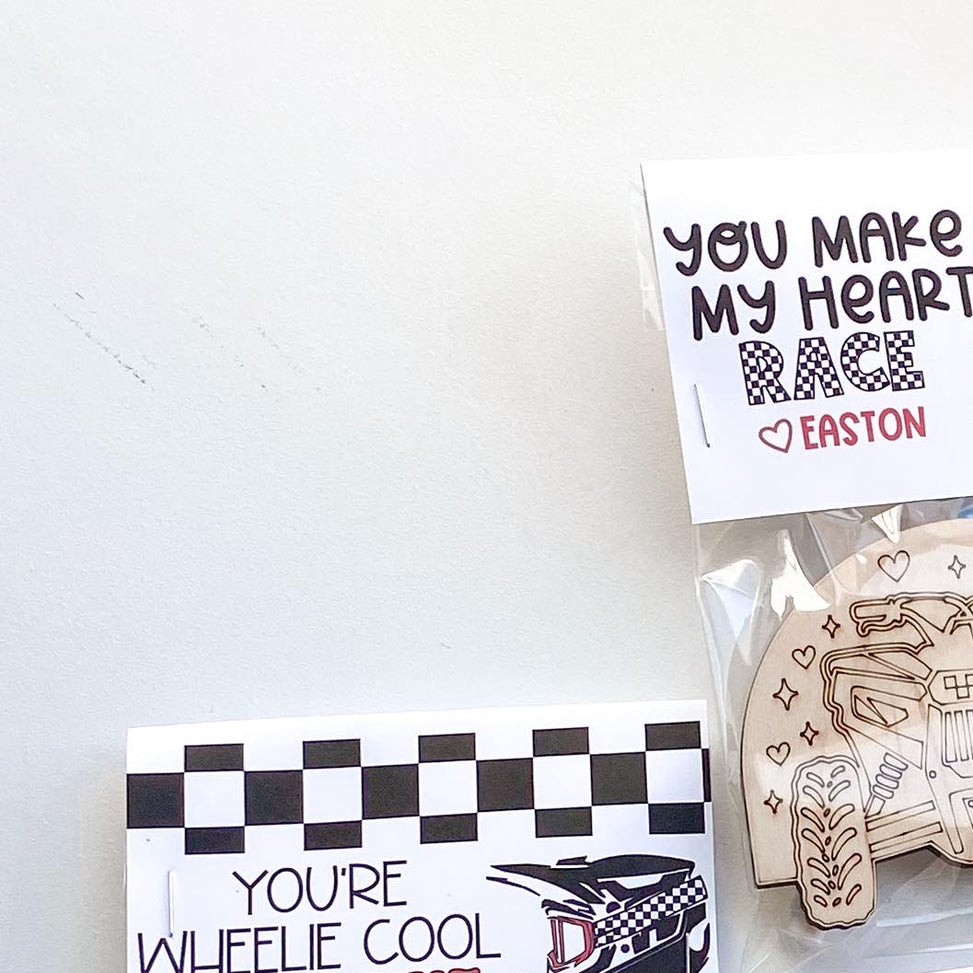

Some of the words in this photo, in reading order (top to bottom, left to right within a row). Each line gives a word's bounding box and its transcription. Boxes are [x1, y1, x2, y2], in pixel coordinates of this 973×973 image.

[738, 331, 925, 406] RACE
[800, 406, 927, 450] EASTON
[232, 860, 407, 915] YOU'RE
[363, 913, 502, 965] COOL
